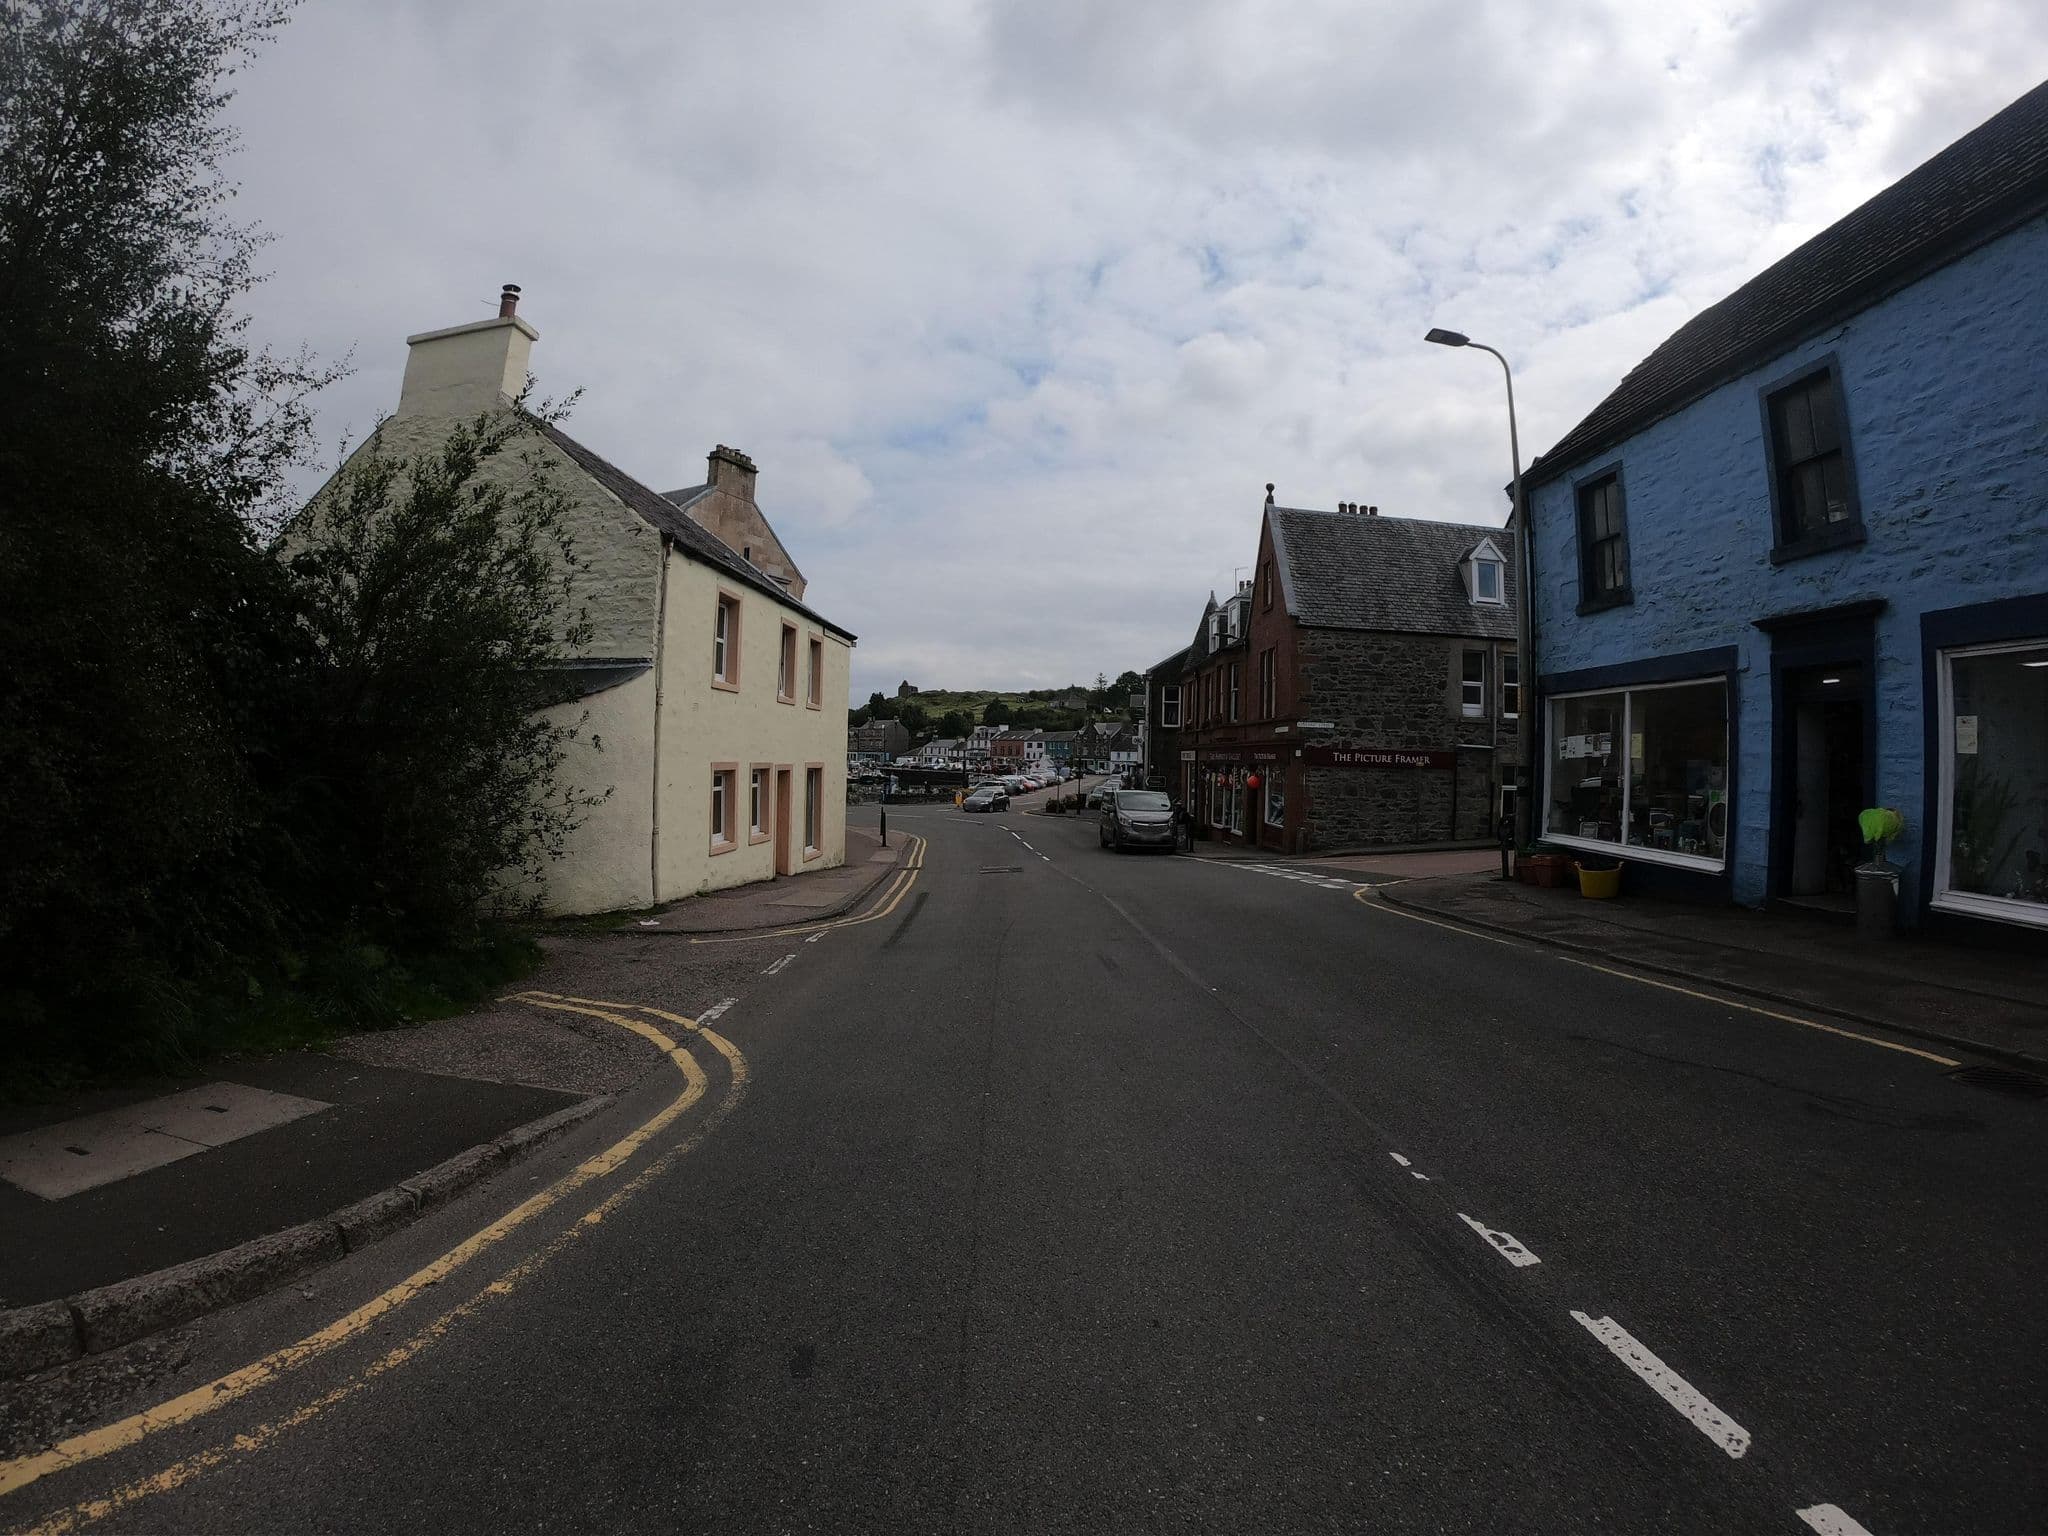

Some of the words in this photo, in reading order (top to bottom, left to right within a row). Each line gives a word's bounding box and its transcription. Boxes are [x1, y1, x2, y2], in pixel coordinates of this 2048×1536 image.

[1332, 752, 1352, 762] THE
[1354, 753, 1392, 763] PICTURE
[1395, 754, 1431, 764] FRAMER
